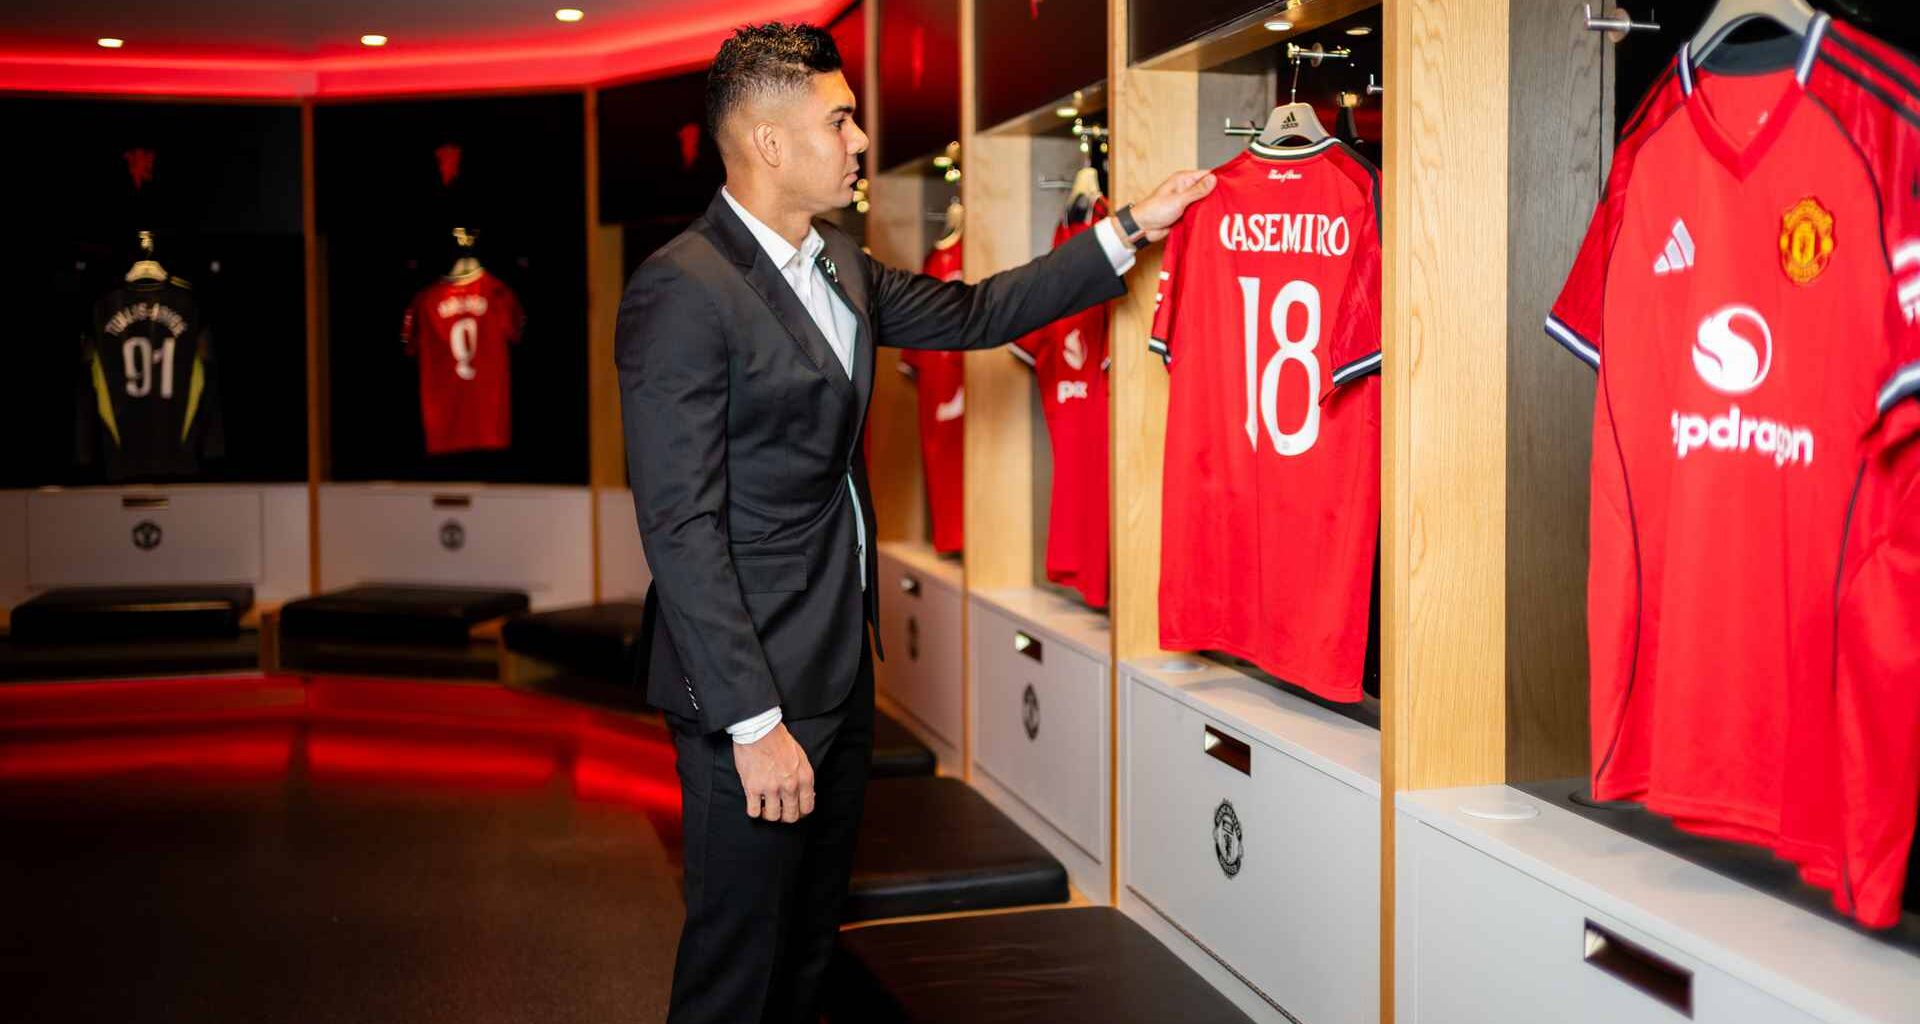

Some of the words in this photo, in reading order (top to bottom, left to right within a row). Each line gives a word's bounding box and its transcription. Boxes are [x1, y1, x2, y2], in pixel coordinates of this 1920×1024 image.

[1219, 212, 1350, 257] CASEMIRO
[122, 336, 176, 399] 91
[1237, 276, 1322, 456] 18
